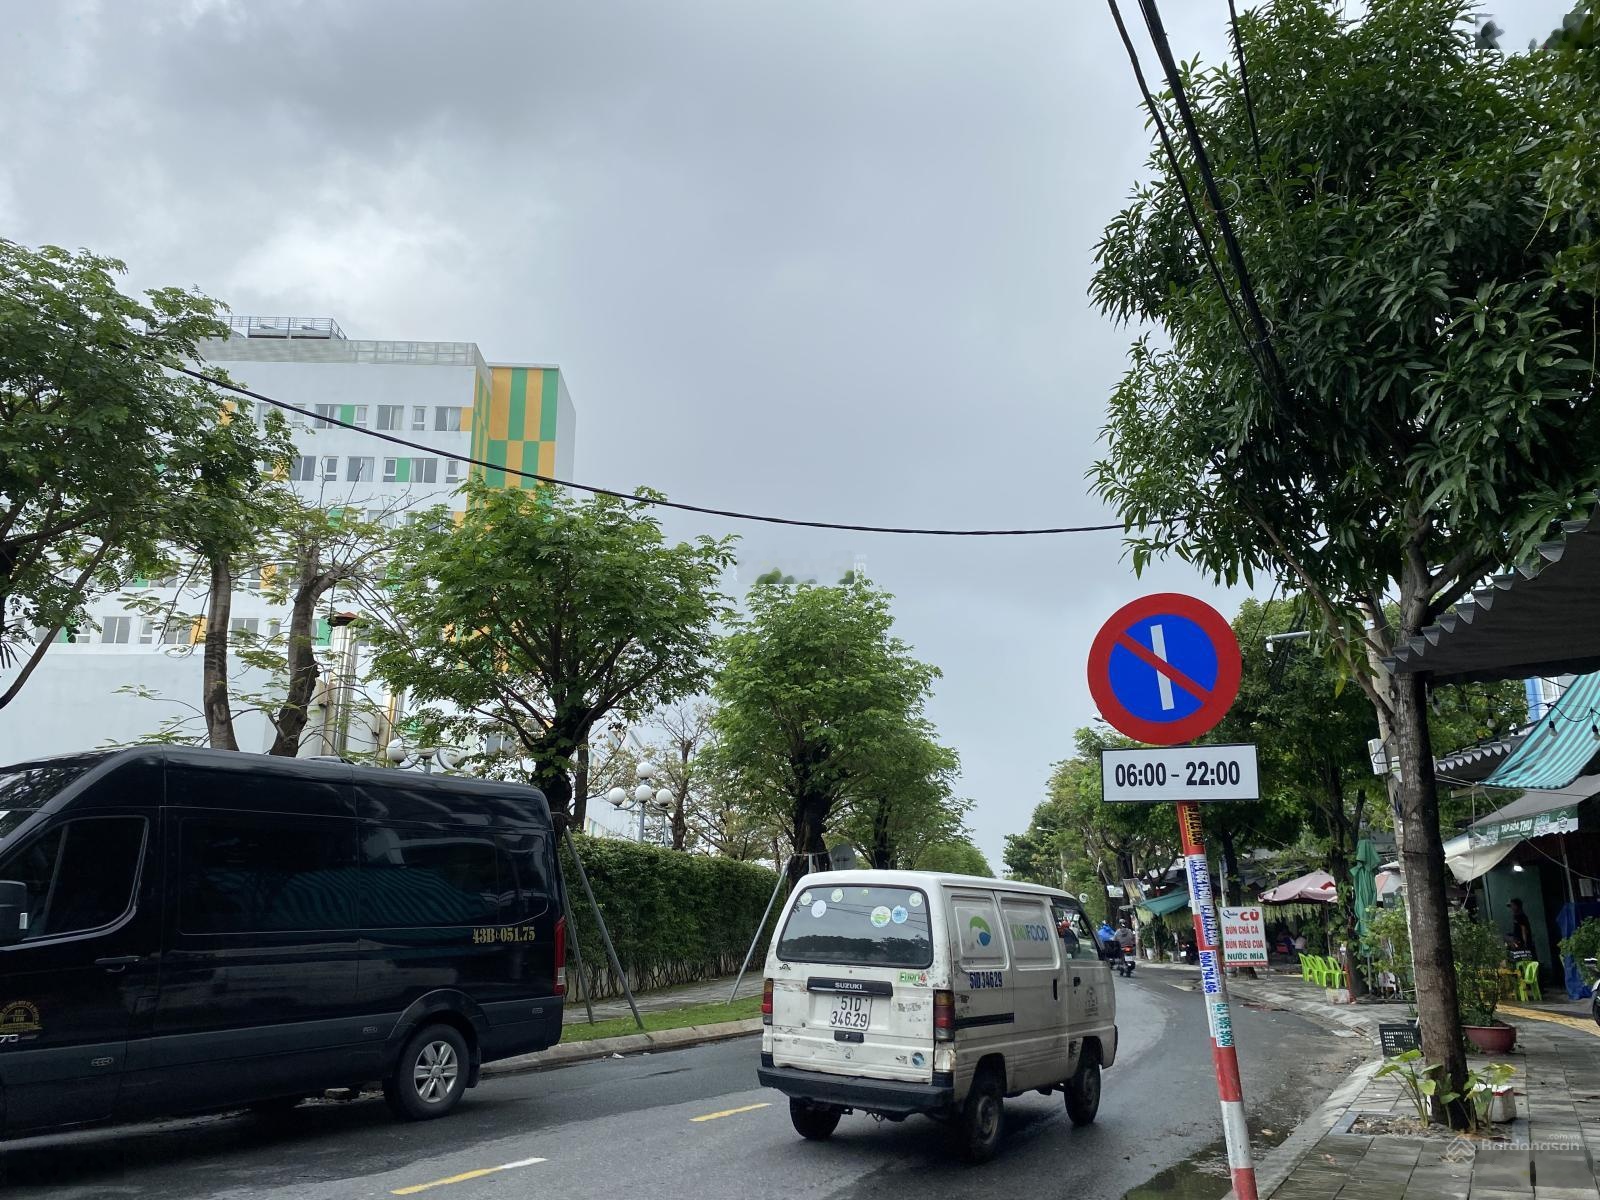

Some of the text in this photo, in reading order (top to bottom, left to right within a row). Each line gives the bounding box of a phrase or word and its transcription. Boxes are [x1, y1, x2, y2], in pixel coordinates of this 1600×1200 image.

[1115, 763, 1167, 787] 06:00
[1185, 760, 1241, 786] 22:00
[1227, 951, 1265, 960] NƯỚC MÍA
[835, 982, 863, 990] SUZUKI
[840, 996, 862, 1012] 51D
[830, 1011, 868, 1028] 346.29
